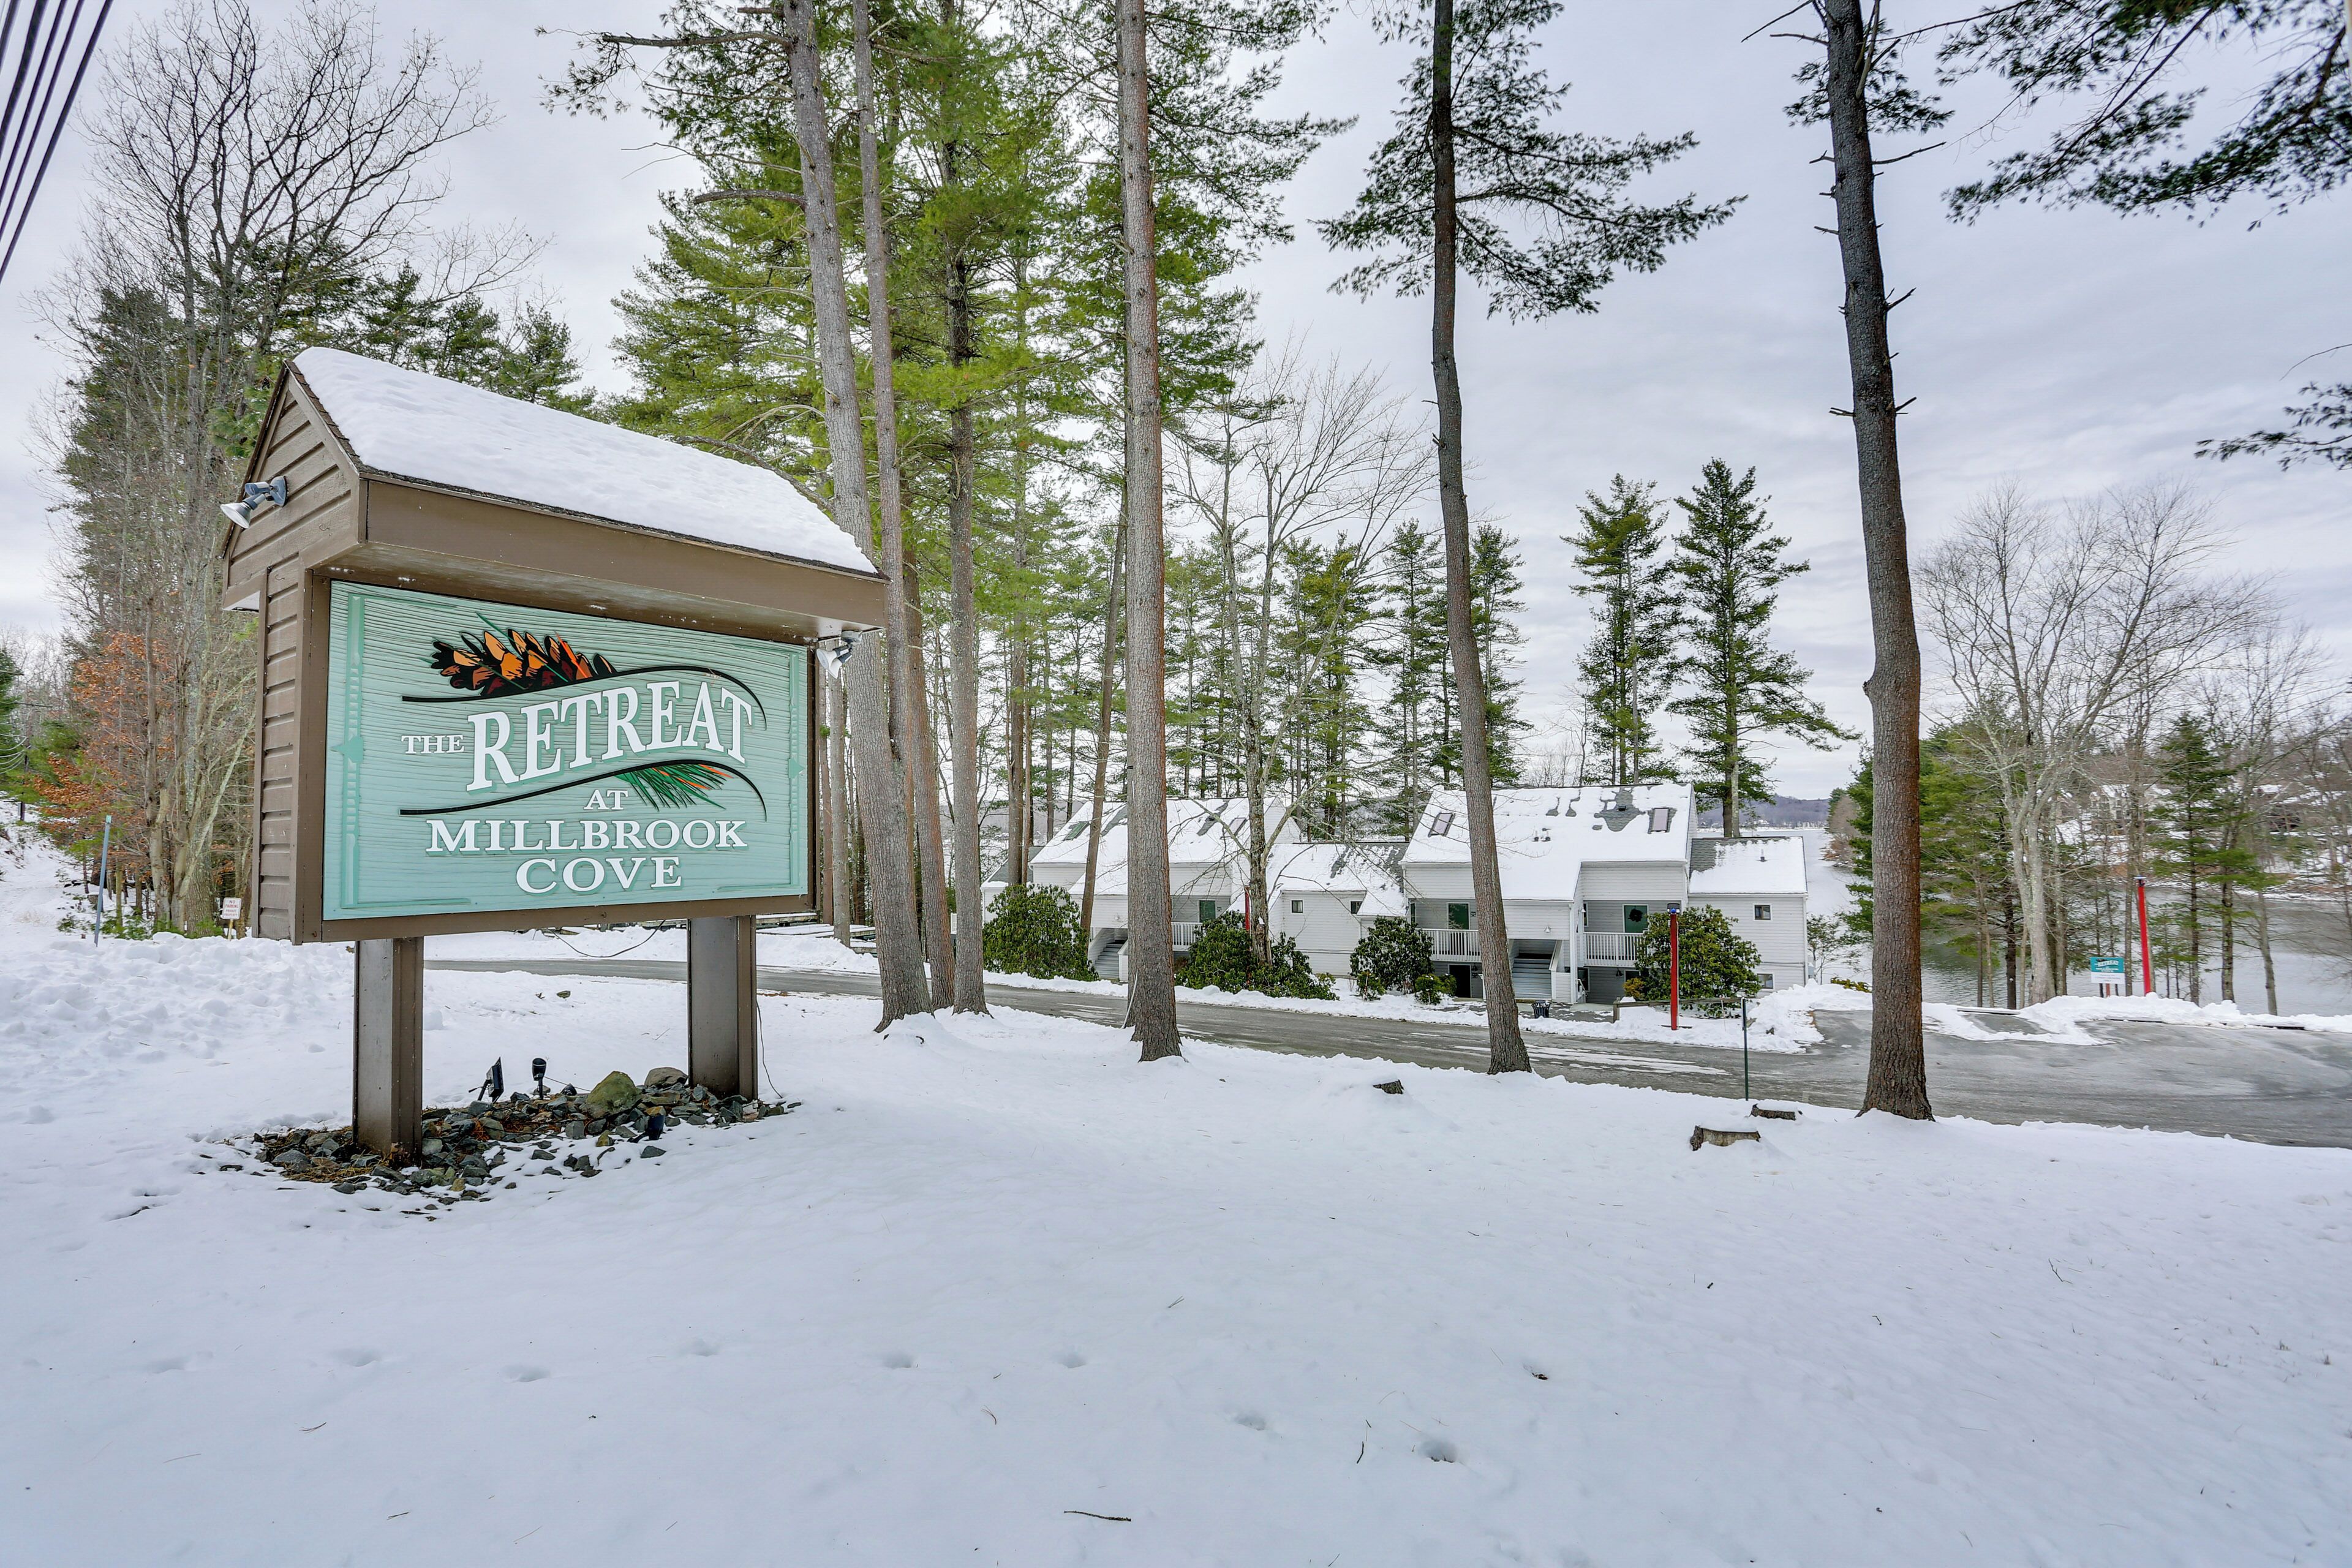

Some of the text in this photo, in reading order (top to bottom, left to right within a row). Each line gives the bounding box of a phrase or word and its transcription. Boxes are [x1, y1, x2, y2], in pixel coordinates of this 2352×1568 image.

[401, 680, 753, 792] THE RETREAT
[583, 789, 628, 810] AT
[425, 820, 748, 853] MILLBROOK
[515, 856, 682, 894] COVE
